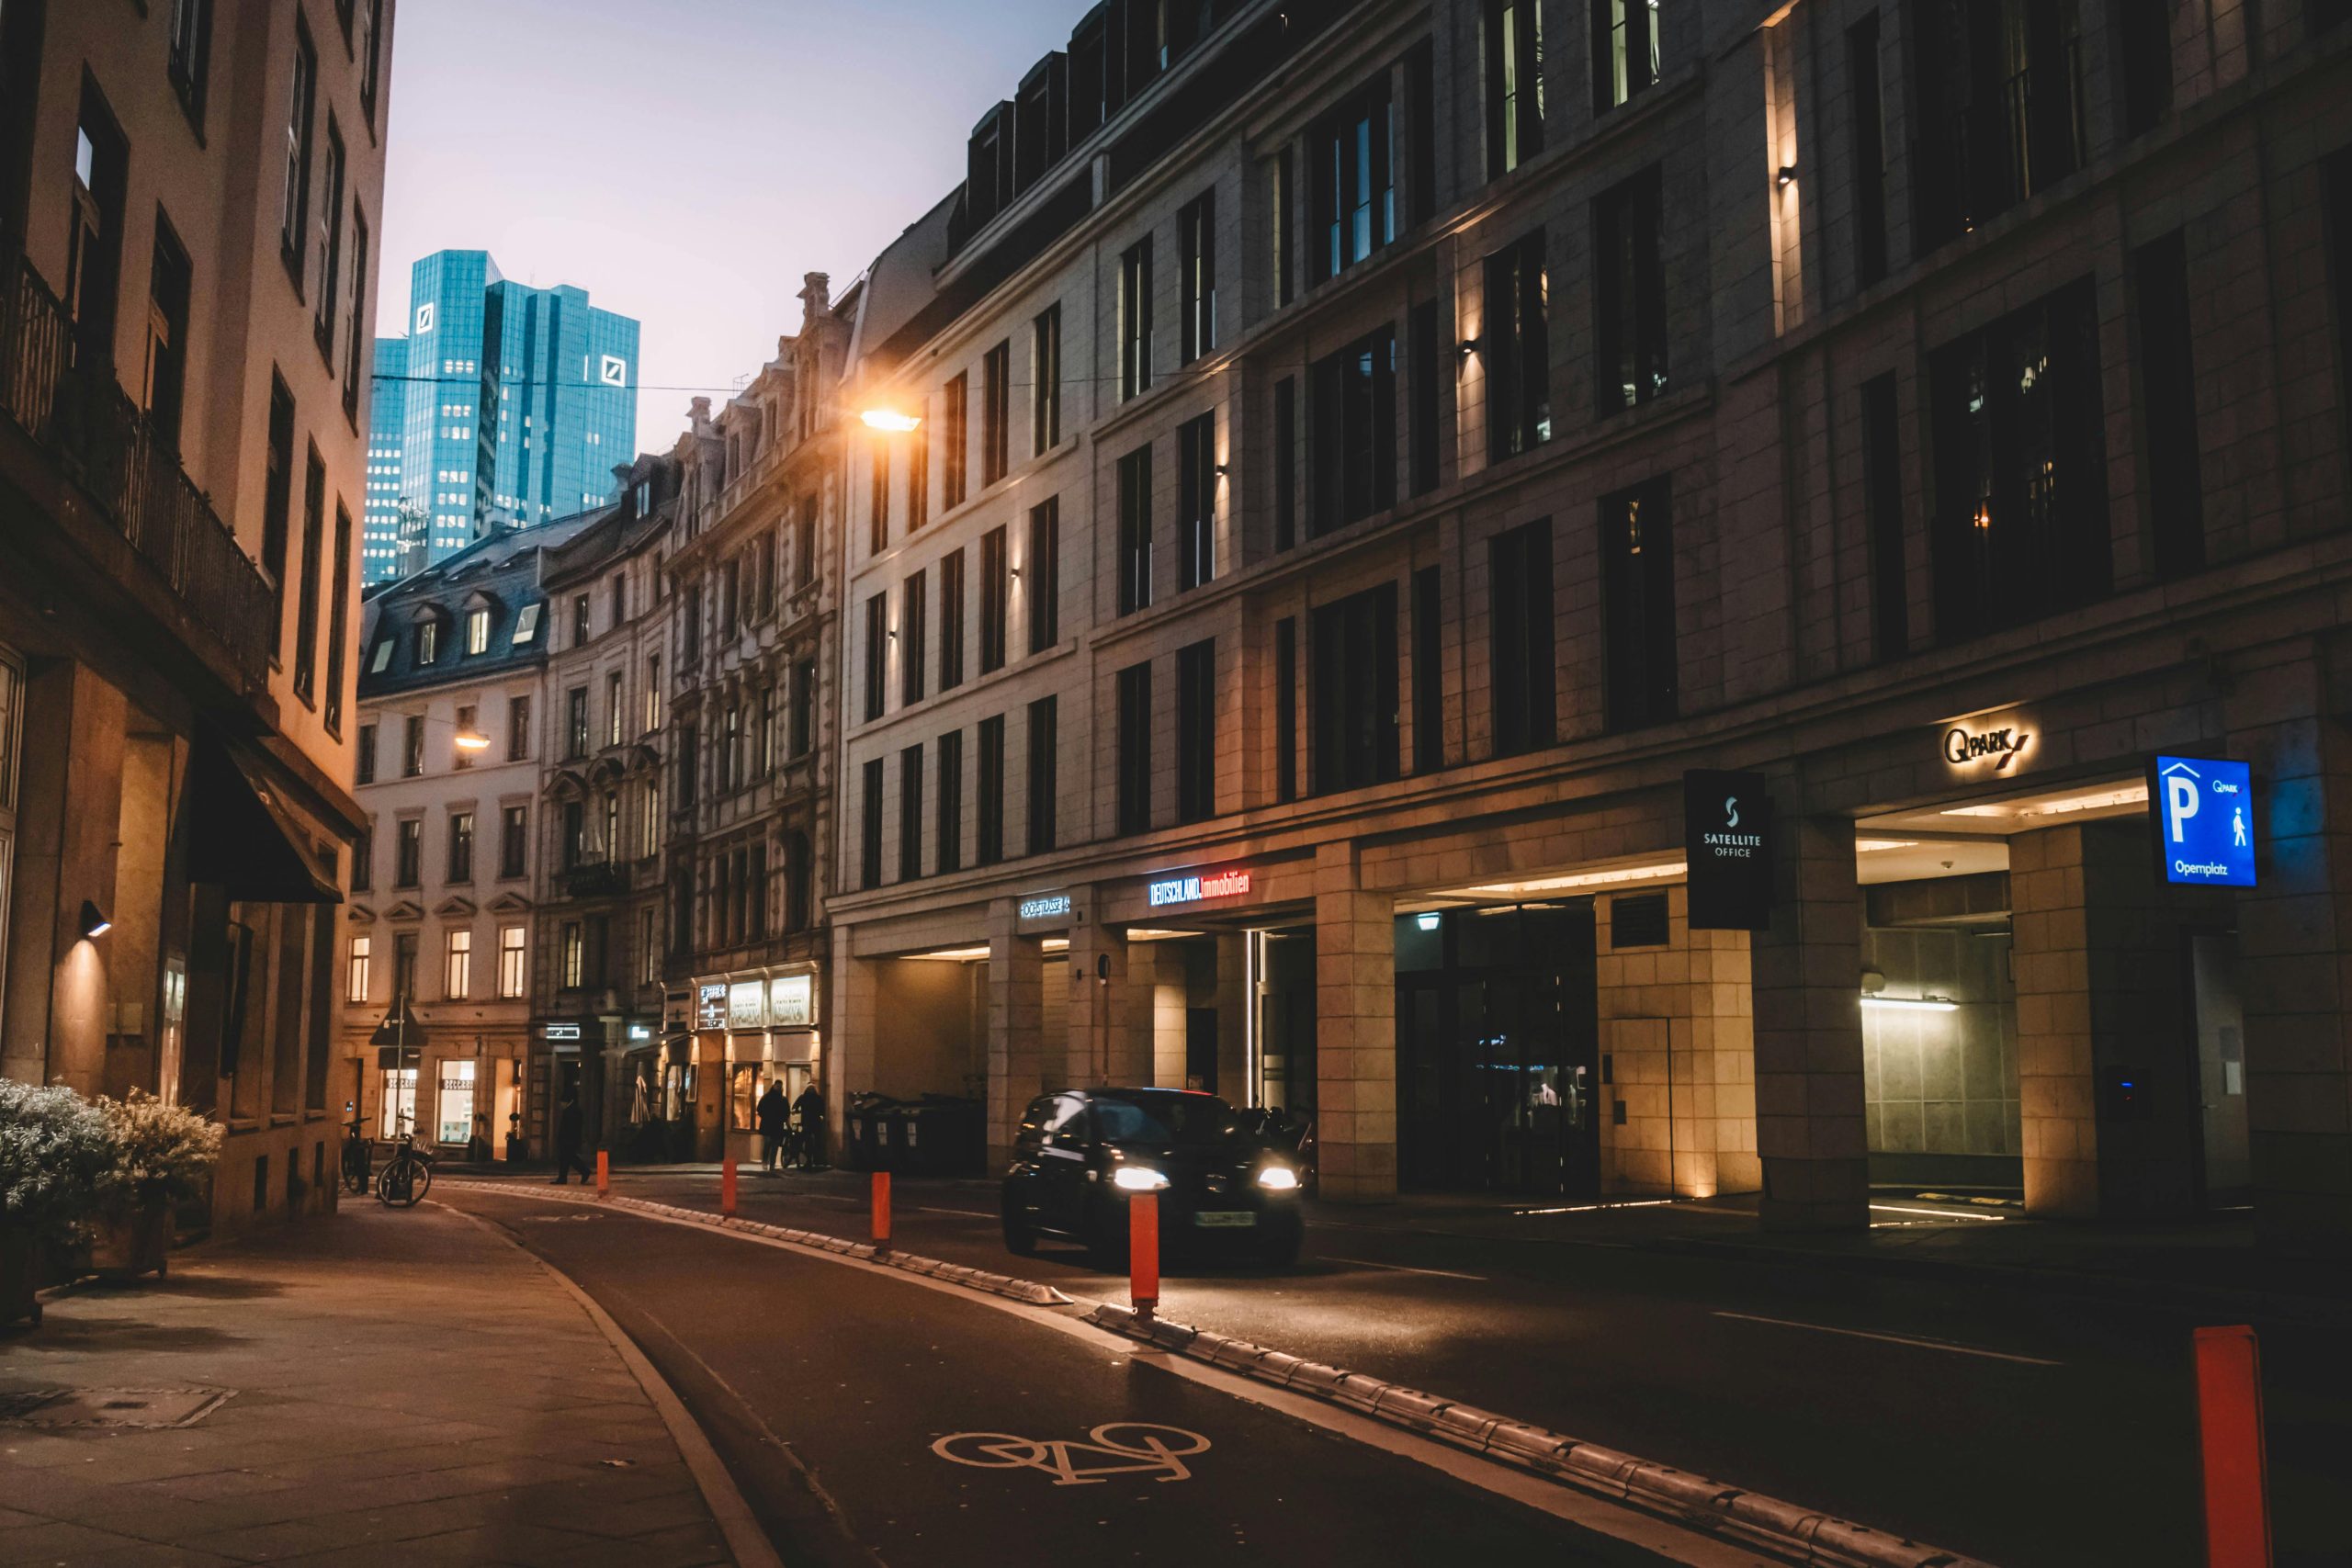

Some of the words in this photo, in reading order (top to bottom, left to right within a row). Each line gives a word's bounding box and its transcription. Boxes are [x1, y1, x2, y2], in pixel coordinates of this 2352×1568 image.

[2168, 776, 2199, 843] P
[1704, 833, 1760, 846] SATELLITE
[1714, 847, 1750, 858] OFFICE
[2175, 860, 2228, 877] Opernplatz
